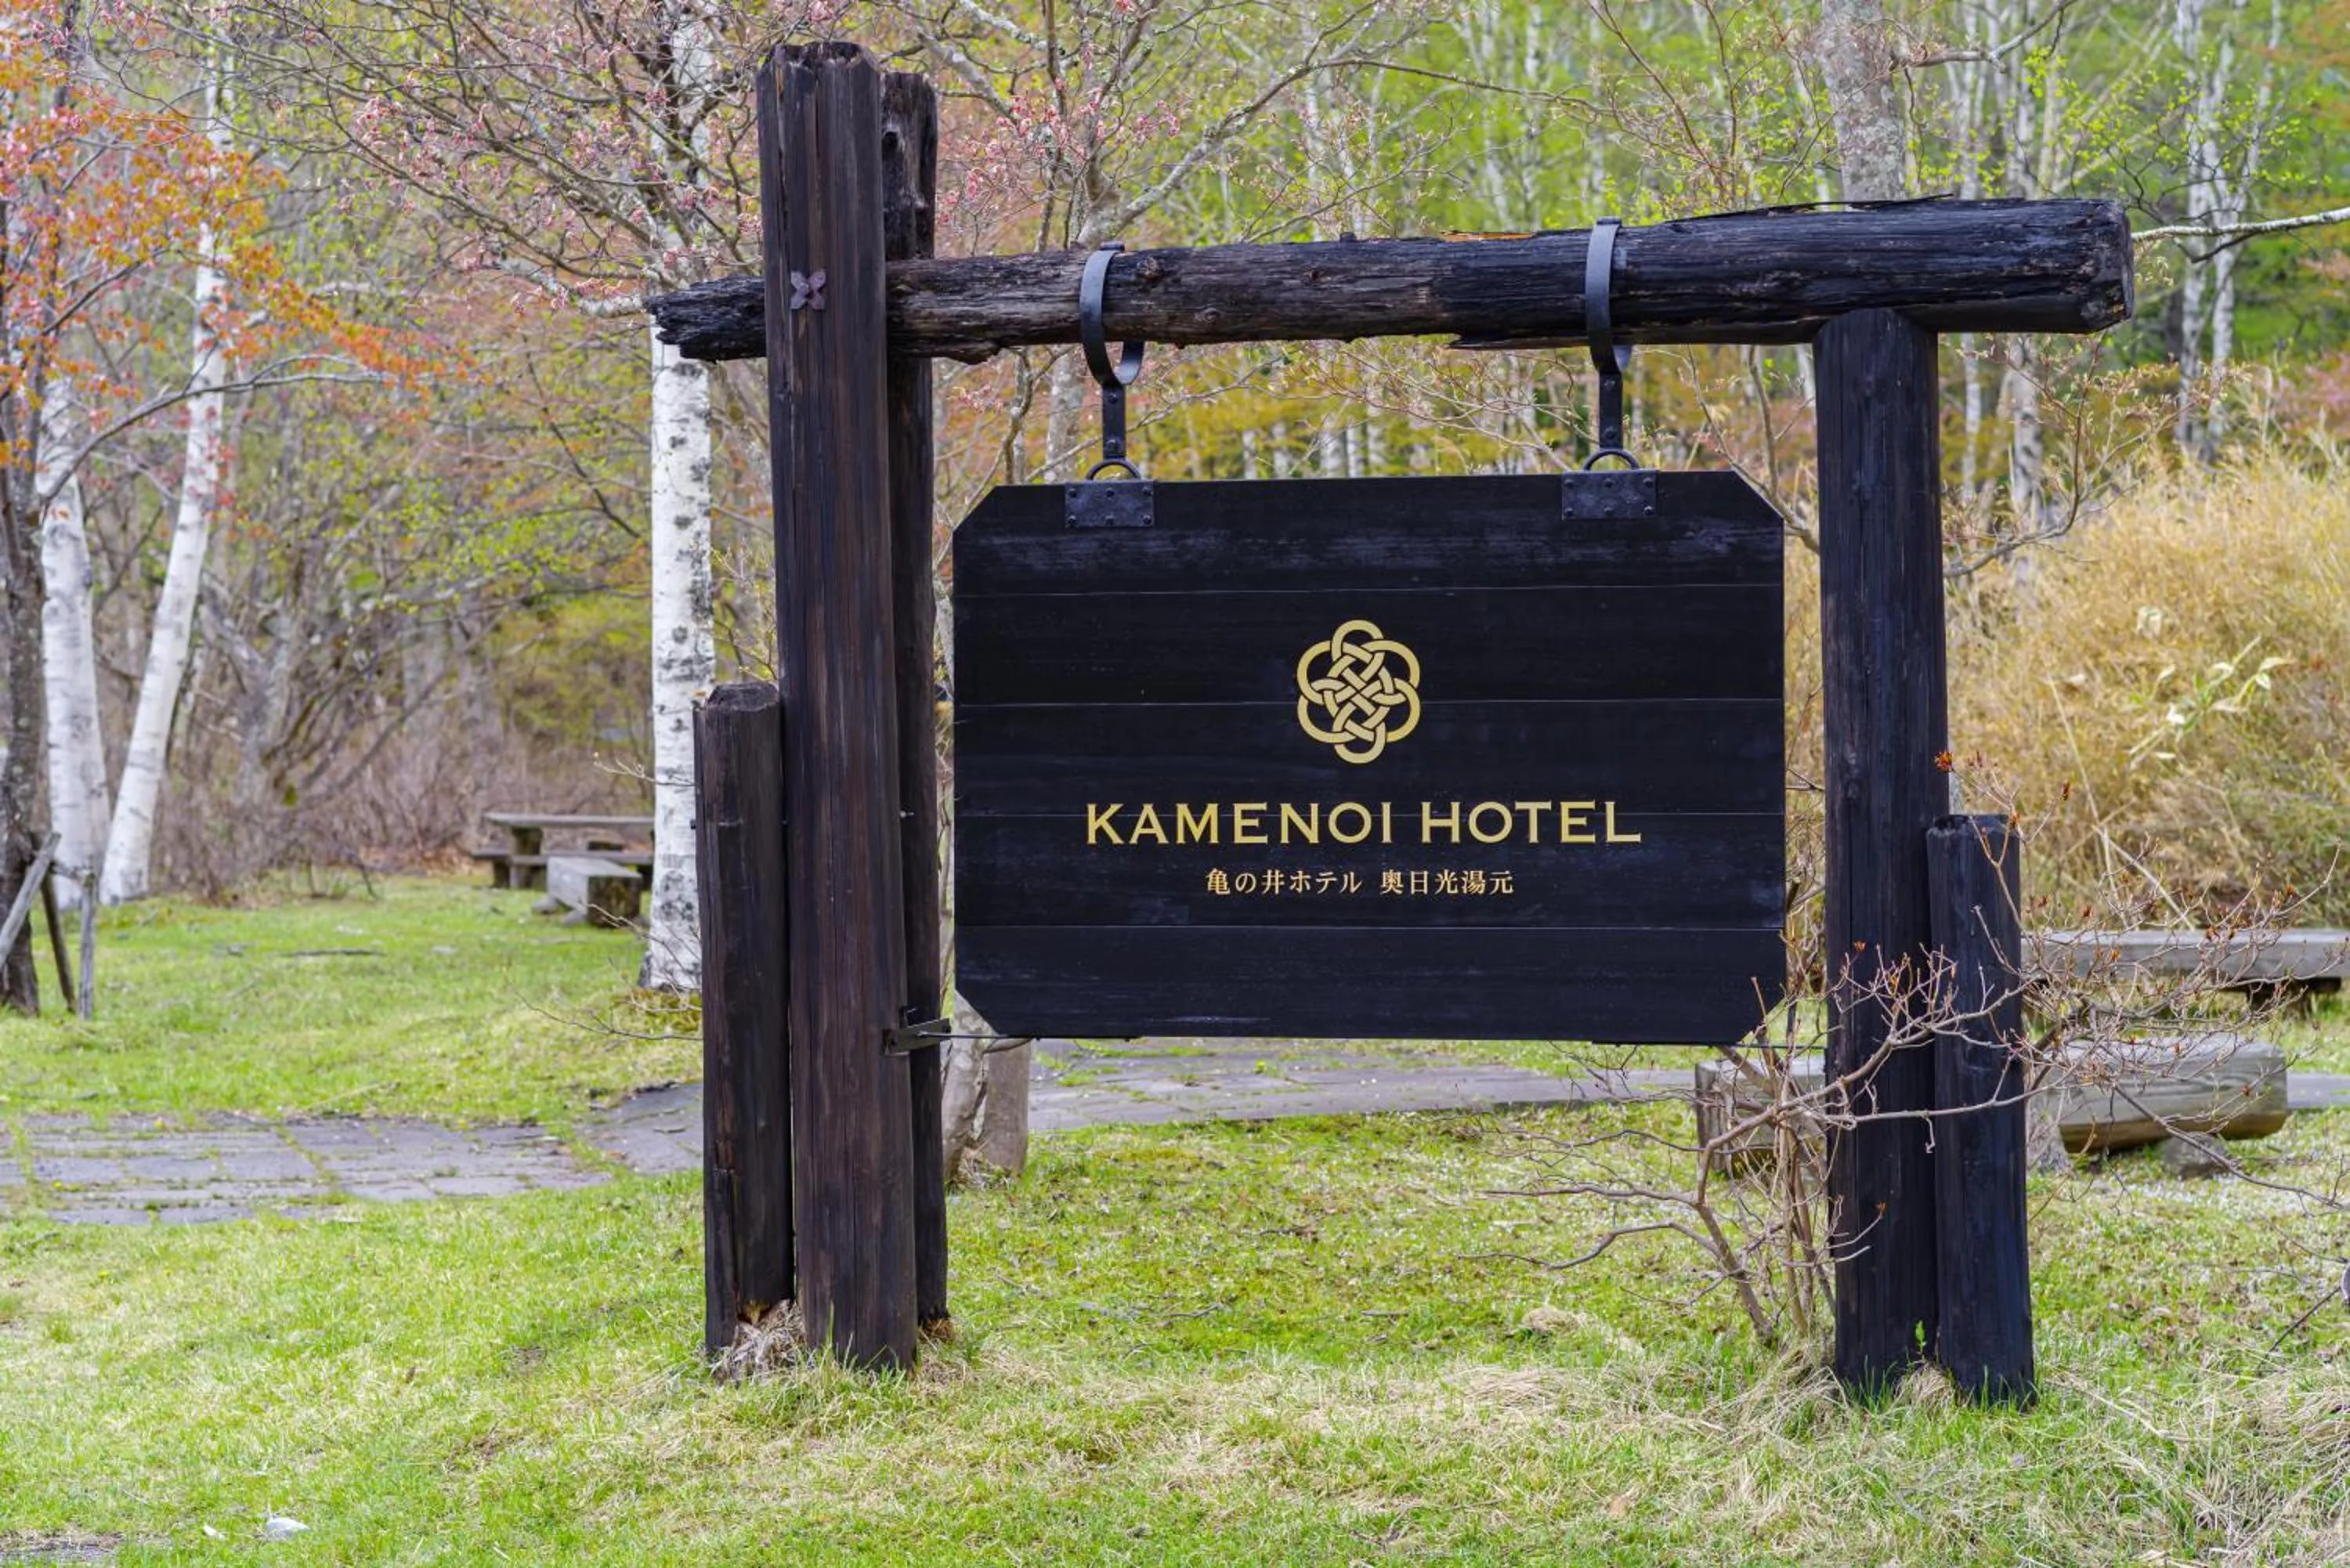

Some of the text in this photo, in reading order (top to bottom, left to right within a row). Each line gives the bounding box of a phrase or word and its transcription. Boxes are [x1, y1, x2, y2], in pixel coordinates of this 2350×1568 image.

[1086, 800, 1643, 844] KAMENOI HOTEL
[1206, 868, 1516, 895] 亀の井ホテル 奥日光湯元
